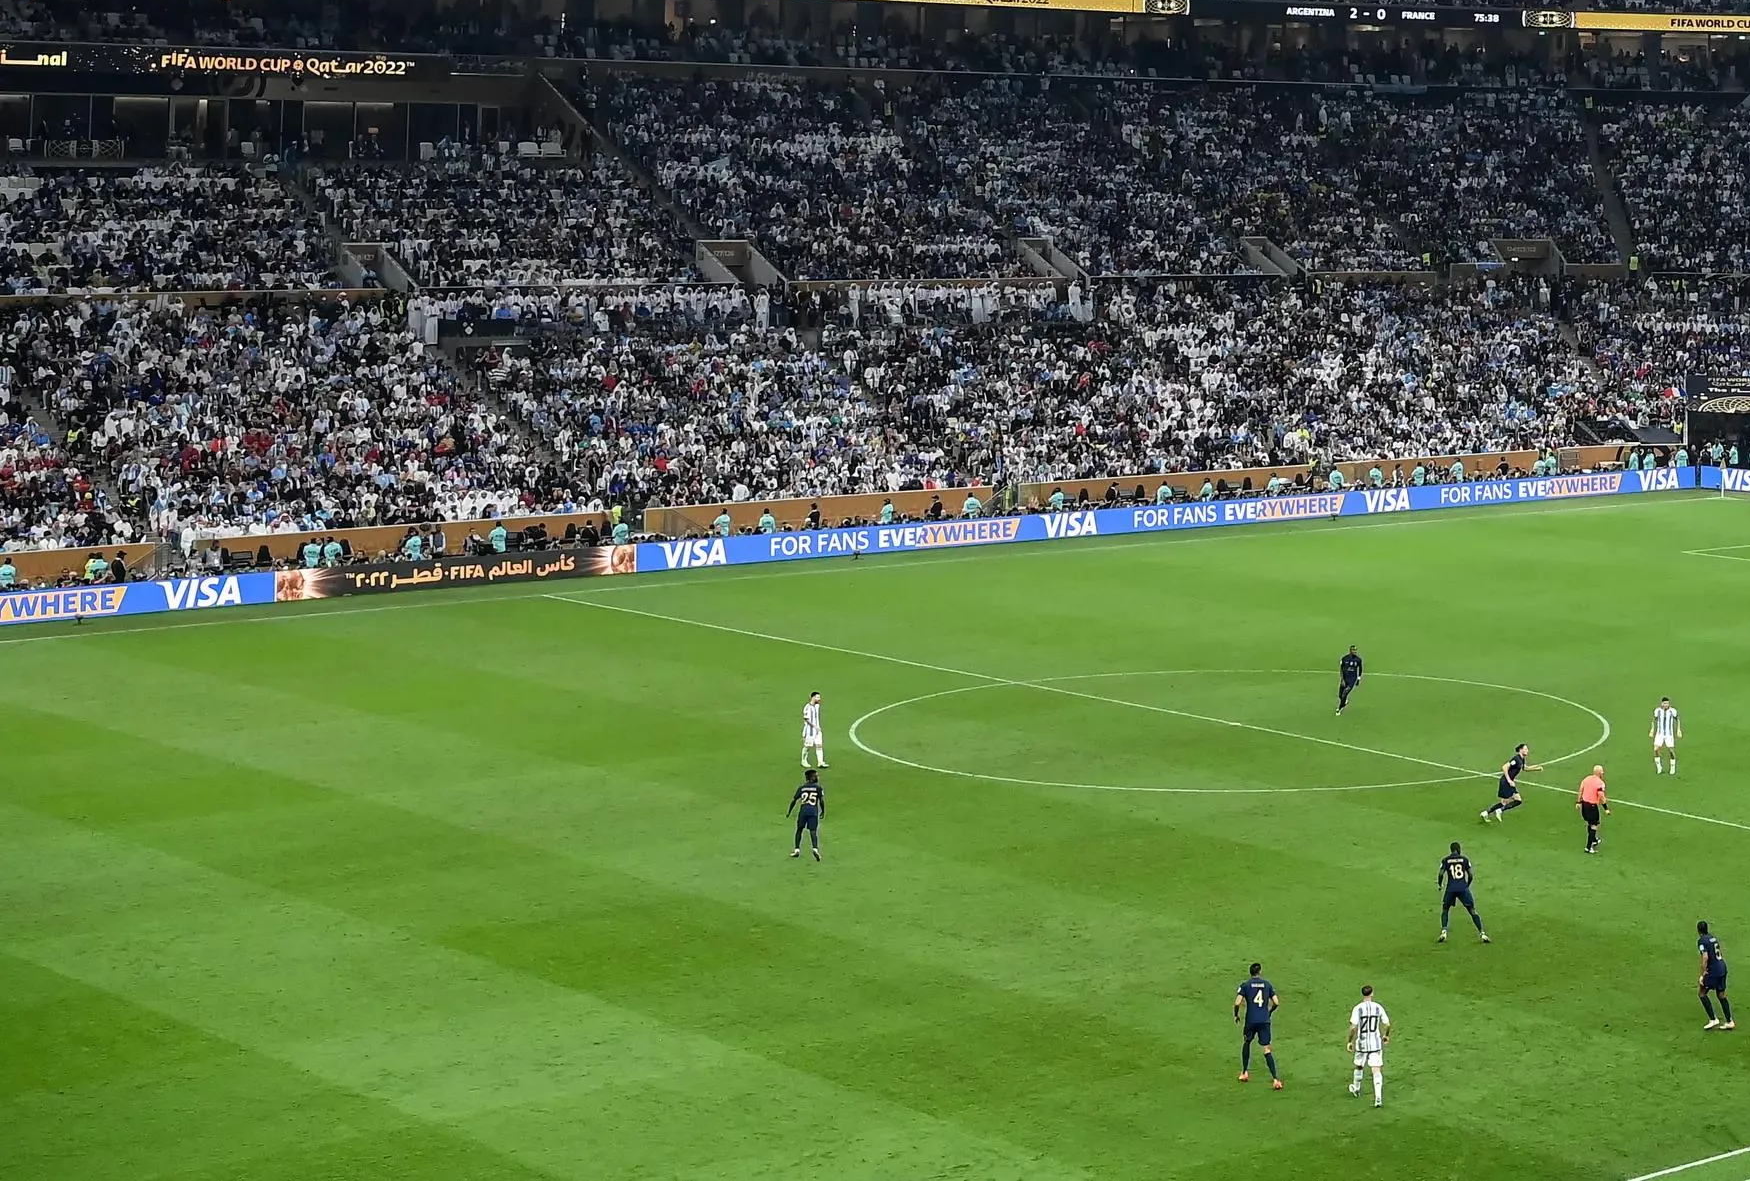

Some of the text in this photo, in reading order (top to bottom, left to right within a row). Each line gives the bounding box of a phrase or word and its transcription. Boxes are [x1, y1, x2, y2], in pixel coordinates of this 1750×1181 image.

[1286, 6, 1336, 18] ARGENTINA
[1349, 8, 1358, 19] 2
[1376, 8, 1387, 21] 0
[1401, 11, 1436, 21] FRANCE
[1474, 13, 1500, 24] 75:38
[1670, 18, 1694, 27] FIFA
[1695, 18, 1735, 29] WORLD
[161, 50, 197, 69] FIFA
[199, 55, 258, 71] WORLD
[259, 56, 291, 72] CUP
[1441, 476, 1617, 504] FOR FANS EVERYWHERE
[1636, 469, 1680, 493] VISA
[1360, 488, 1411, 513] VISA
[1134, 496, 1339, 528] FOR FANS EVERYWHERE
[1040, 511, 1098, 539] VISA
[770, 520, 1013, 558] FOR FANS EVERYWHERE
[657, 538, 727, 570] VISA
[451, 563, 485, 579] FIFA
[488, 559, 533, 581] العالم
[536, 555, 576, 577] كأس
[156, 575, 243, 610] VISA
[801, 792, 818, 806] 25
[1450, 863, 1464, 880] 18
[1253, 989, 1265, 1008] 4
[1360, 1015, 1378, 1033] 20
